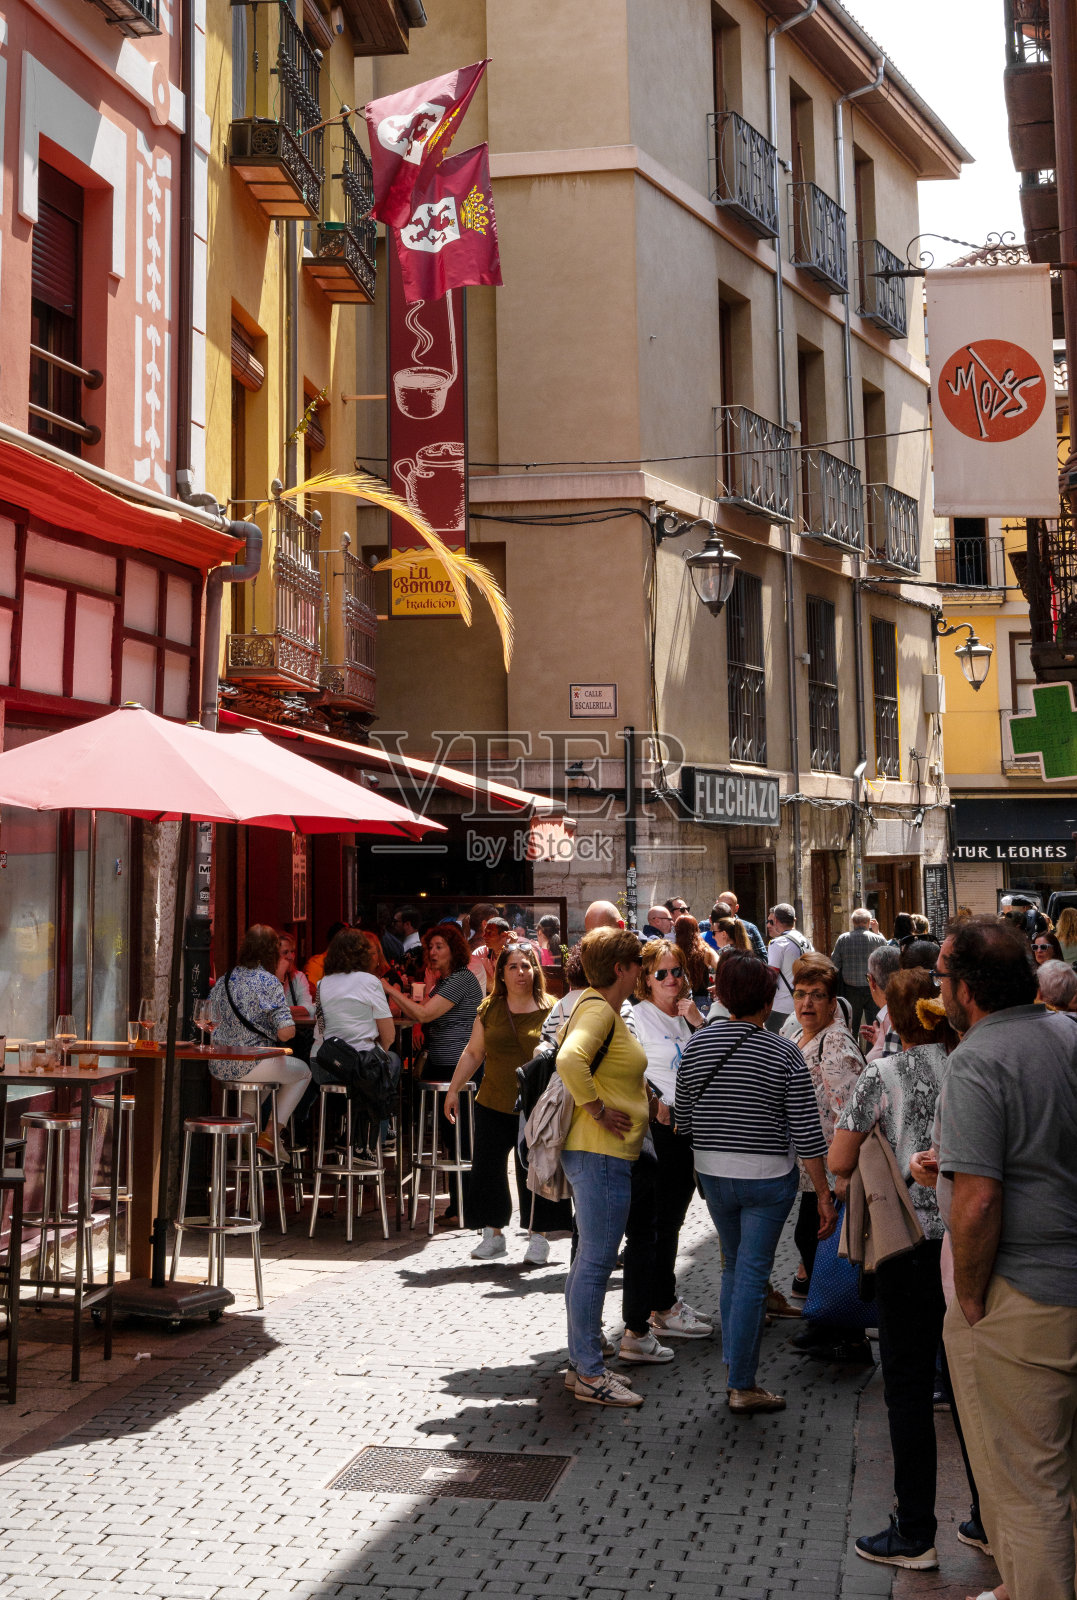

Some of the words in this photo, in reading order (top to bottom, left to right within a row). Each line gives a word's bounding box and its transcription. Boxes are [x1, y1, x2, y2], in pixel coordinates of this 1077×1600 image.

[584, 690, 603, 698] CALLE
[574, 701, 613, 710] ESCALERILLA
[695, 774, 778, 819] FLECHAZO
